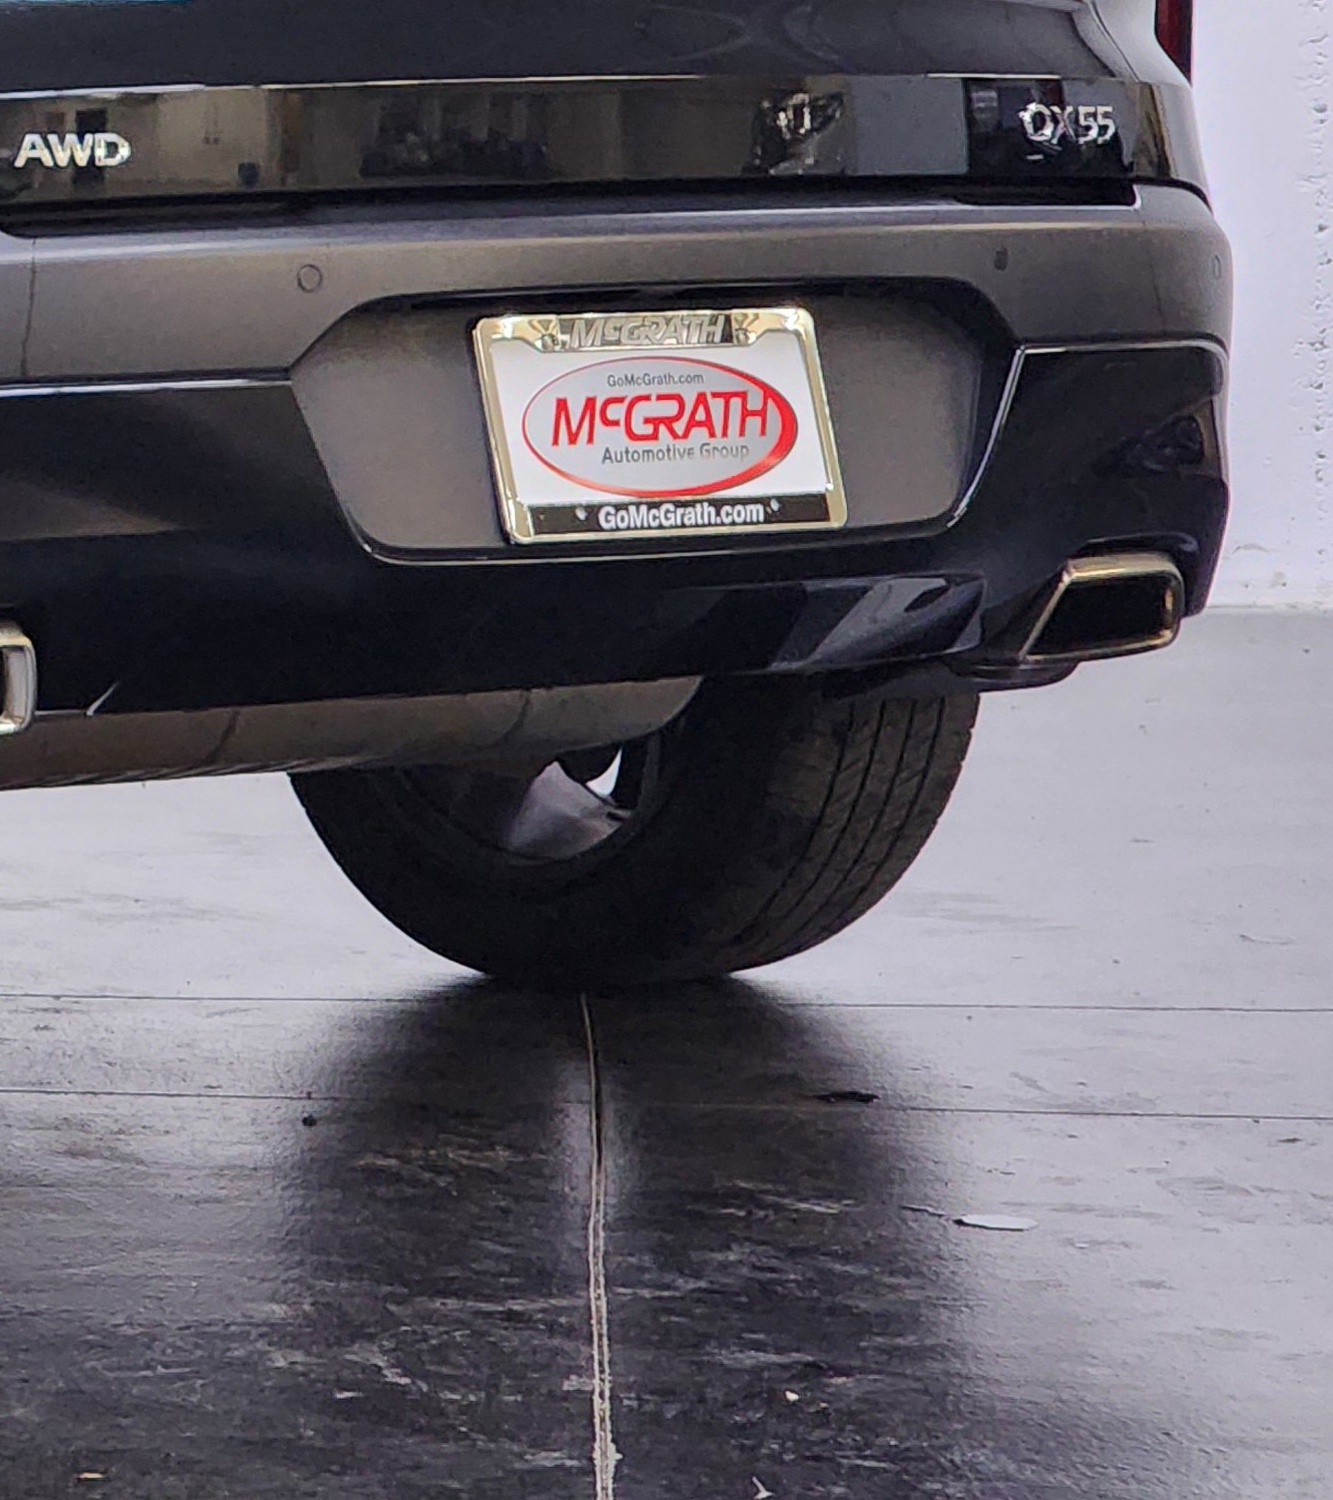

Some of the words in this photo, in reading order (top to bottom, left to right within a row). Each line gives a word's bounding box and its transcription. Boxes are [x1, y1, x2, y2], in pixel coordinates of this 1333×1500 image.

[1018, 102, 1117, 146] QX55
[13, 132, 132, 168] AWD
[606, 371, 705, 389] GoMcGrath.com
[601, 444, 696, 465] Automotive
[699, 442, 751, 464] Group
[598, 501, 765, 532] GoMcGrath.com
